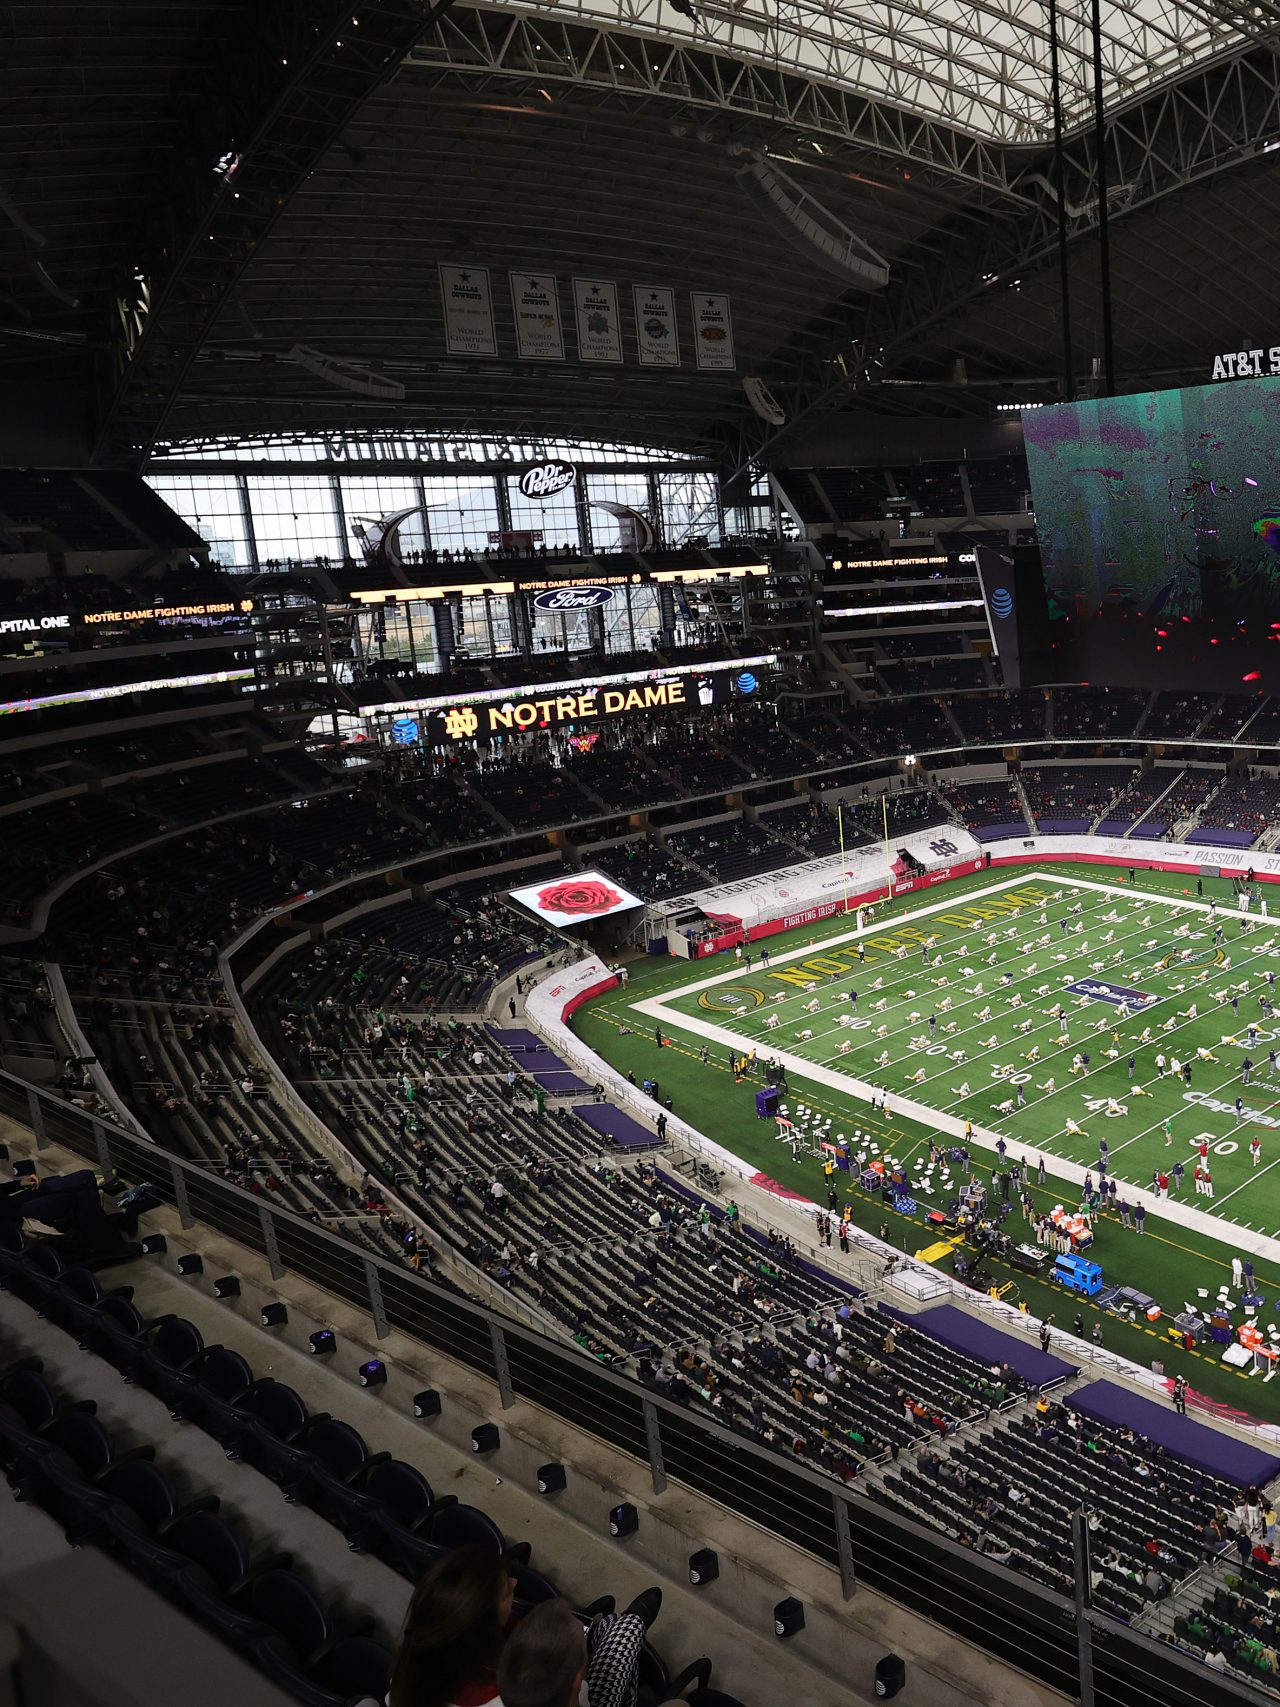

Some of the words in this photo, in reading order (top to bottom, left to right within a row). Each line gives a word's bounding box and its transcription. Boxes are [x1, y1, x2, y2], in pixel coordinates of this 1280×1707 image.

[1211, 349, 1264, 380] AT&T
[527, 468, 573, 495] Pepper
[543, 463, 563, 480] Dr
[894, 557, 928, 566] FIGHTING
[519, 582, 546, 590] NOTRE
[547, 580, 570, 588] DAME
[571, 578, 606, 587] FIGHTING
[607, 575, 628, 584] IRISH
[549, 589, 598, 608] Ford
[84, 612, 121, 624] NOTRE
[123, 609, 153, 621] DAME
[155, 605, 204, 618] FIGHTING
[206, 603, 235, 613] IRISH
[0, 619, 41, 634] PITAL
[41, 616, 70, 630] ONE
[90, 688, 121, 699] NOTRE
[122, 684, 146, 695] DAME
[188, 675, 212, 686] IRISH
[489, 695, 598, 731] NOTRE
[604, 681, 685, 715] DAME
[1193, 850, 1244, 866] PASSION
[704, 866, 797, 899] FIGHTING
[784, 911, 816, 928] FIGHTING
[818, 903, 837, 921] IRISH
[766, 926, 945, 988] NOTRE
